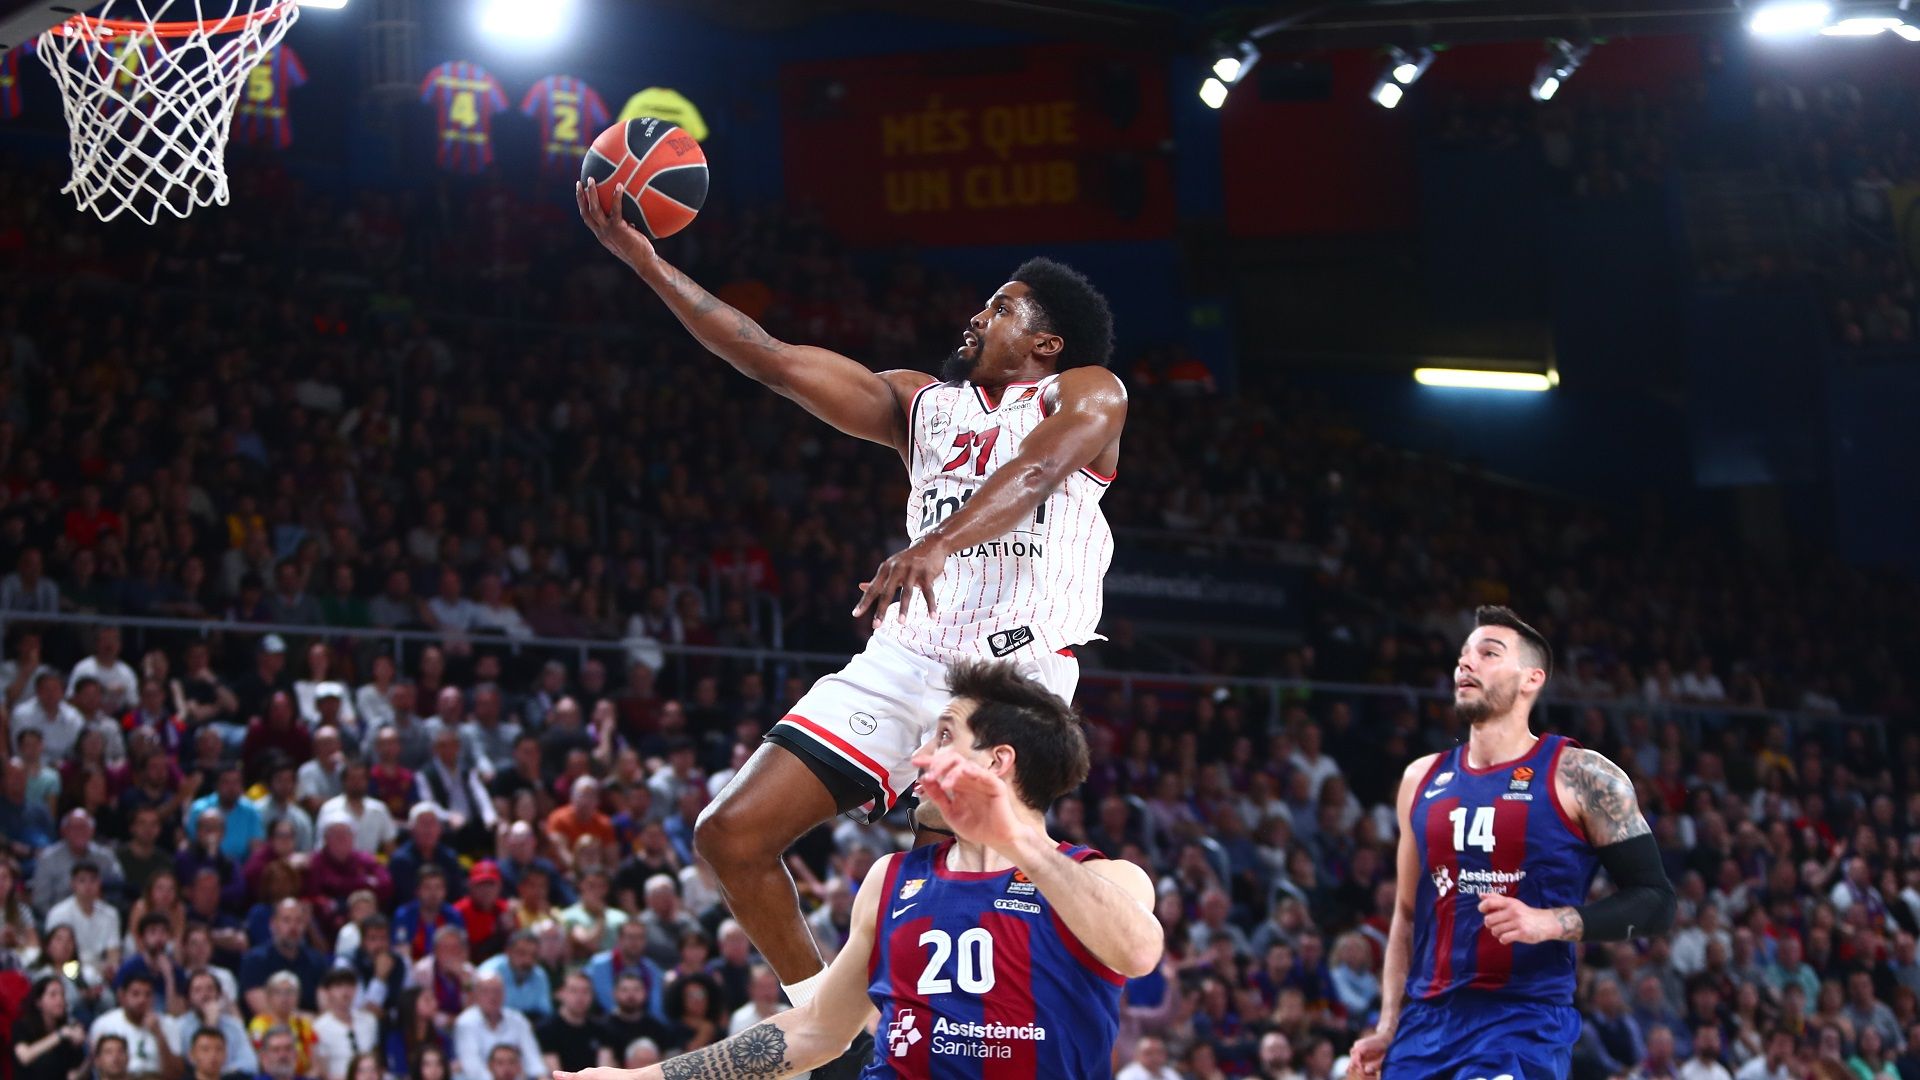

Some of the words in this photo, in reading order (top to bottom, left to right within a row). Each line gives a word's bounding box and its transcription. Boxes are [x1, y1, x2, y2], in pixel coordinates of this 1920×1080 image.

[250, 65, 275, 101] 5
[451, 91, 477, 127] 4
[554, 105, 579, 141] 2
[882, 94, 970, 156] MÉS
[982, 100, 1078, 159] QUE
[884, 169, 950, 213] UN
[964, 161, 1077, 208] CLUB
[949, 542, 1042, 558] DATION
[1449, 806, 1496, 852] 14
[995, 900, 1040, 913] oneteam
[917, 928, 995, 995] 20
[931, 1035, 1012, 1059] Sanitària
[932, 1017, 1046, 1041] Assistència
